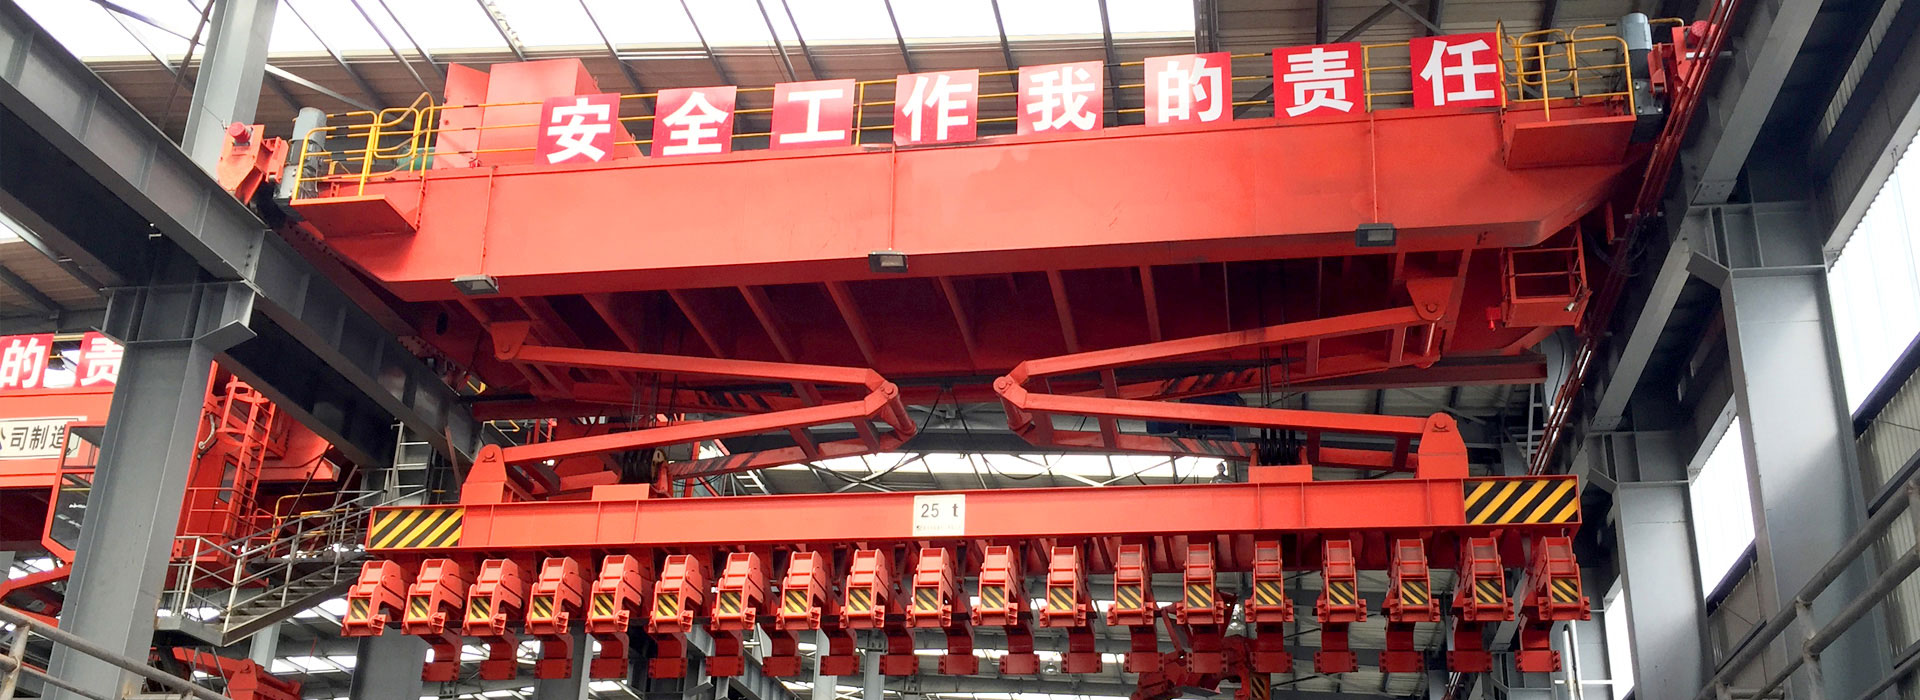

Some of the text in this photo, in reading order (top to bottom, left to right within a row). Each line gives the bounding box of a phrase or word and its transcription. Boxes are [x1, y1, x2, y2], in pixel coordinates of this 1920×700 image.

[545, 40, 1498, 164] 安全工作我的责任
[921, 503, 959, 518] 25 t
